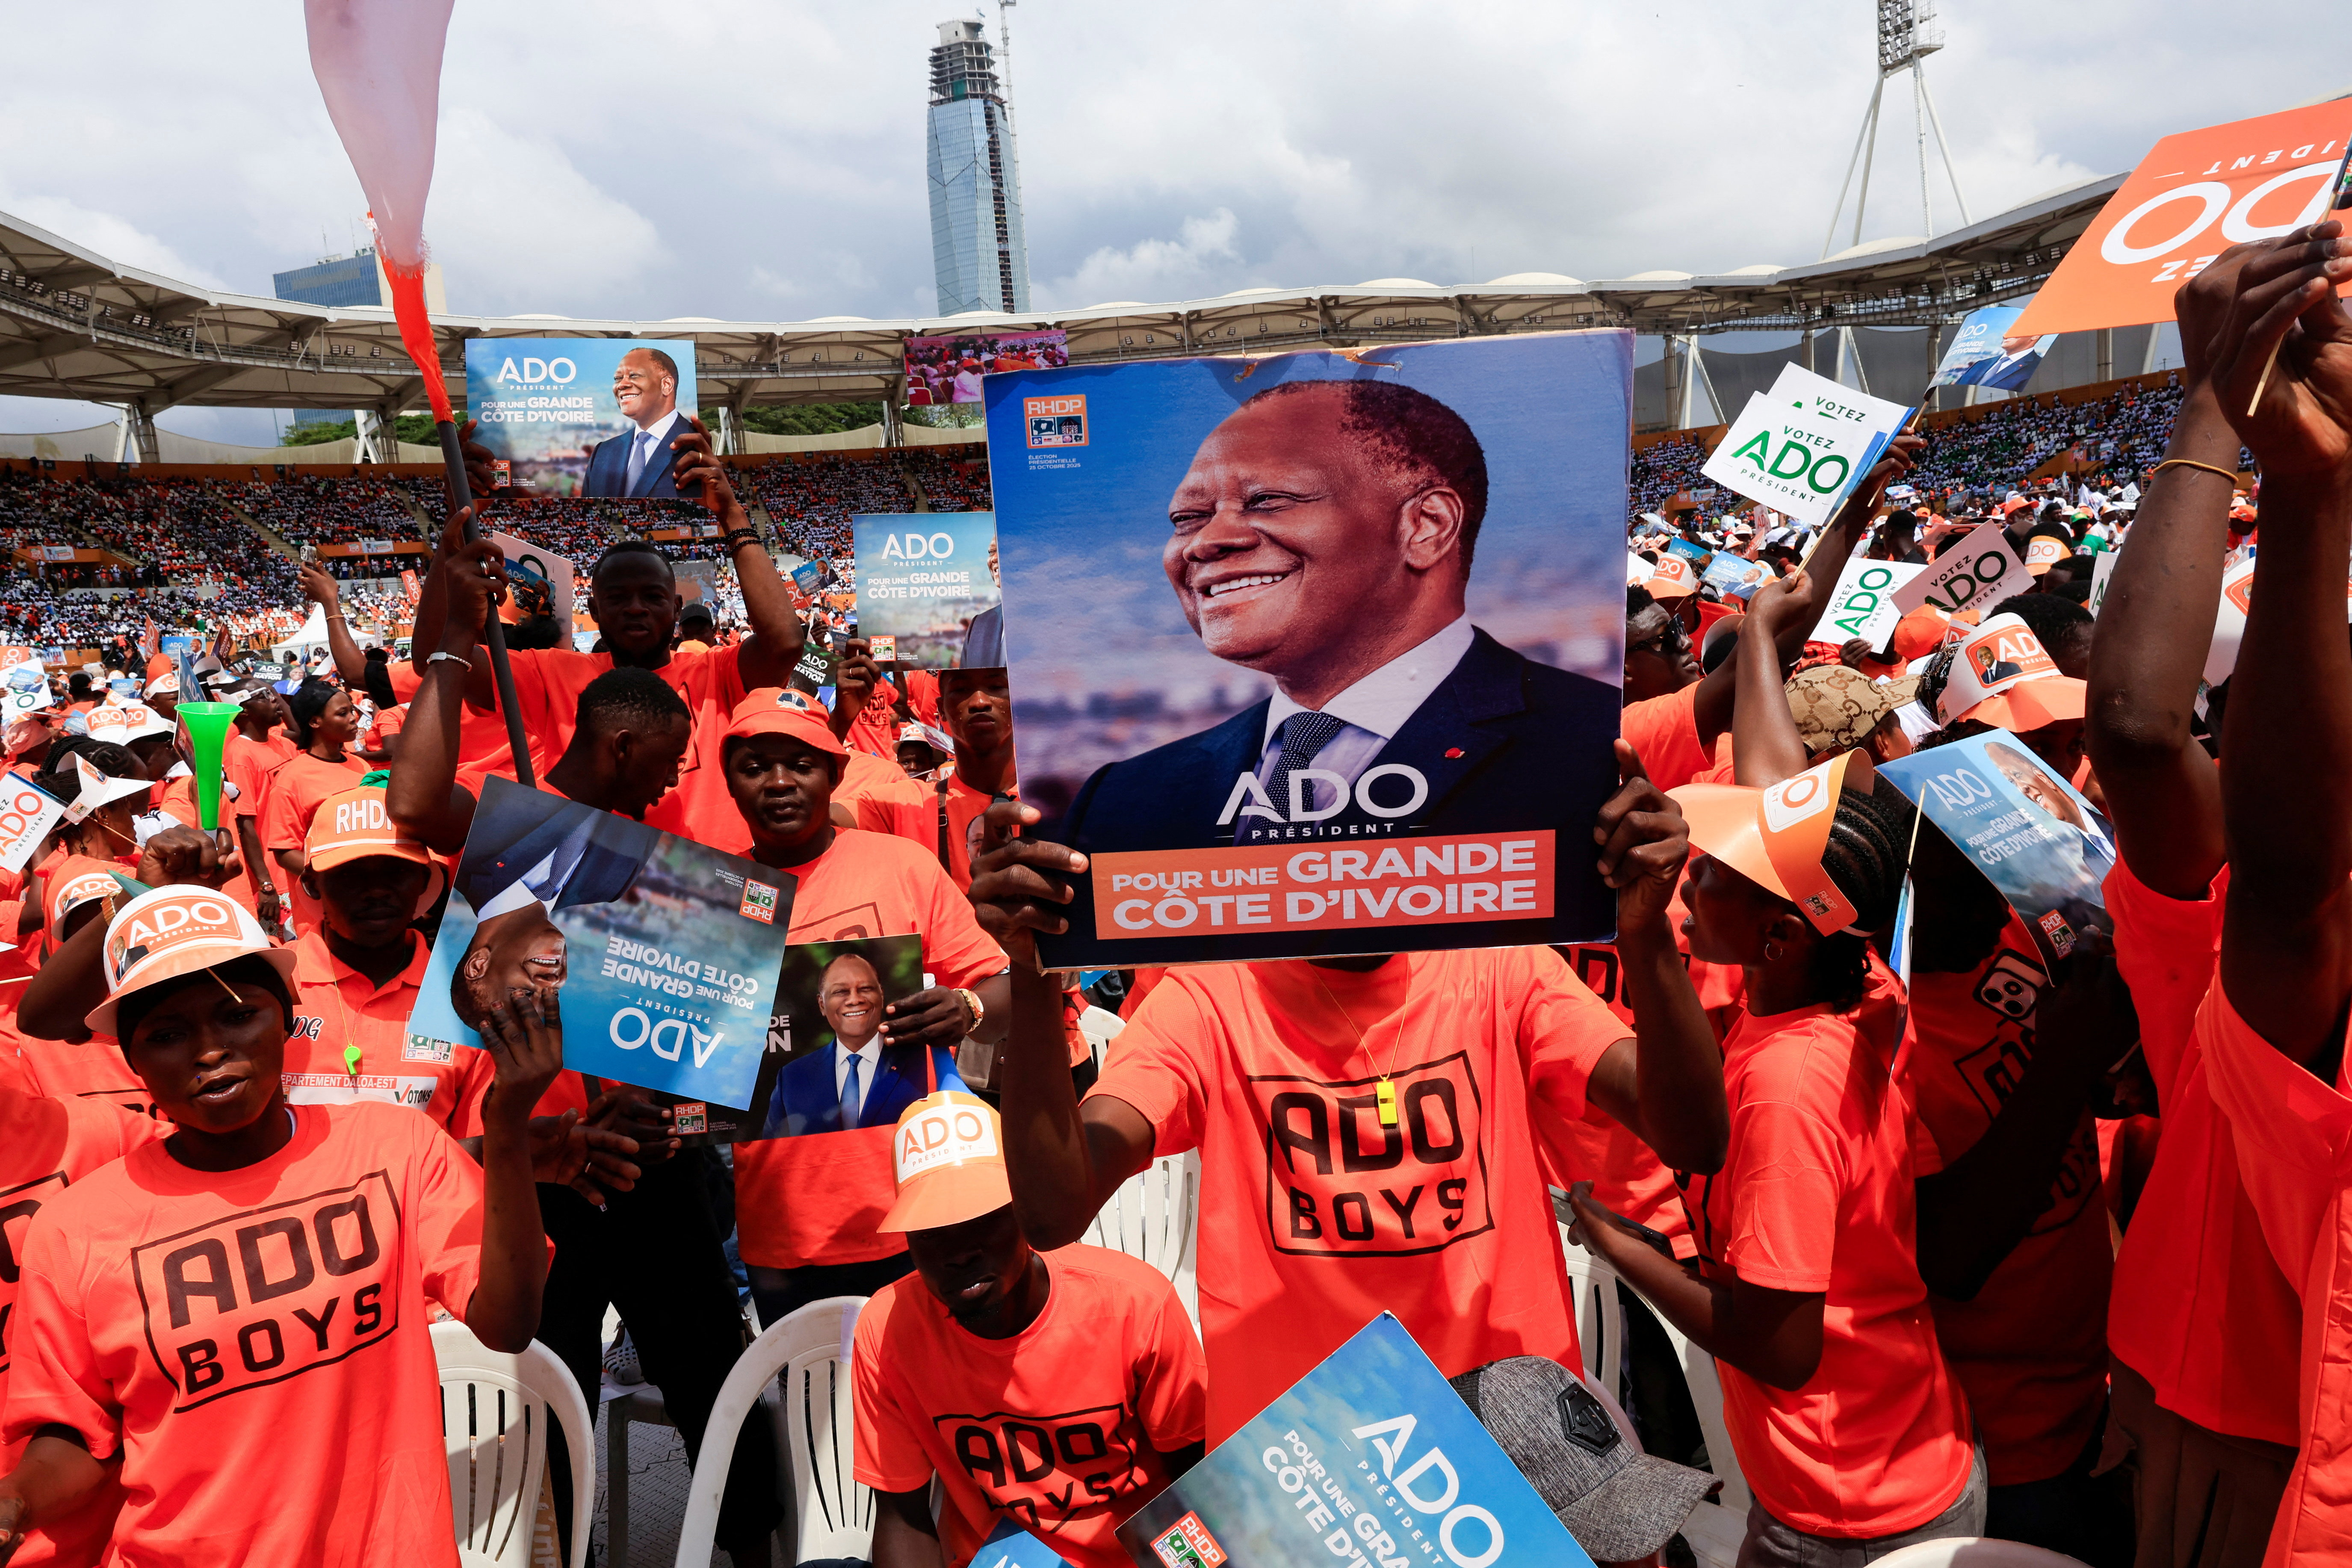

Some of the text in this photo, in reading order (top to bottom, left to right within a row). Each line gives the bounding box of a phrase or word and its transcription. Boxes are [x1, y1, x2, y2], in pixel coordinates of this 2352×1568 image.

[2101, 159, 2343, 264] DO
[1956, 324, 1988, 341] ADO
[496, 357, 576, 384] ADO
[481, 408, 594, 423] CÔTE D'IVOIRE
[528, 397, 593, 409] GRANDE
[1028, 399, 1082, 414] RHDP
[1816, 396, 1866, 422] VOTEZ
[1784, 425, 1835, 449] VOTEZ
[1730, 430, 1849, 494] ADO
[1740, 469, 1816, 502] PRÉSIDENT
[2126, 488, 2136, 501] ADO
[881, 533, 954, 559] ADO
[1677, 547, 1693, 558] ADO
[910, 572, 969, 584] GRANDE
[1720, 560, 1738, 570] ADO
[1930, 555, 1972, 587] VOTEZ
[406, 575, 419, 601] ADO
[868, 585, 970, 599] CÔTE D'IVOIRE
[1924, 551, 2007, 612] ADO
[1830, 584, 1853, 614] VOTEZ
[1834, 568, 1892, 636] ADO
[1870, 581, 1899, 627] PRÉSIDENT
[6, 648, 20, 666] DO
[802, 653, 828, 670] ADO
[793, 665, 824, 684] NATION
[808, 667, 826, 678] GRANDE
[91, 711, 122, 726] ADO
[127, 711, 144, 722] DO
[1216, 763, 1428, 825] ADO
[1926, 768, 1992, 812] ADO
[1964, 800, 1998, 818] PRÉSIDENT
[15, 812, 47, 852] PRÉSIDENT
[1252, 823, 1395, 839] PRÉSIDENT
[1965, 807, 2036, 848] POUR UNE GRANDE
[1979, 823, 2053, 865] CÔTE D'IVOIRE
[725, 871, 740, 880] OCTOBRE
[1112, 839, 1536, 892] POUR UNE GRANDE
[70, 880, 121, 899] ADO
[1818, 890, 1838, 910] RHDP
[742, 904, 773, 921] RHDP
[1113, 879, 1536, 930] CÔTE D'IVOIRE
[129, 902, 228, 949] ADO
[149, 926, 217, 945] PRÉSIDENT
[2041, 913, 2061, 932] RHDP
[606, 936, 758, 995] CÔTE D'IVOIRE
[601, 958, 755, 1010] POUR UNE GRANDE
[636, 997, 710, 1024] PRÉSIDENT
[609, 1007, 725, 1068] ADO
[281, 1075, 395, 1089] EPARTEMENT DALOA-EST
[394, 1084, 432, 1104] VOTONS
[676, 1105, 704, 1115] RHDP
[902, 1111, 983, 1165] ADO
[1271, 1078, 1464, 1175] ADO
[912, 1145, 972, 1167] PRÉSIDNT
[1289, 1177, 1467, 1241] BOYS
[163, 1194, 380, 1330] ADO
[177, 1283, 381, 1395] BOYS
[955, 1421, 1108, 1488] ADO
[1262, 1446, 1335, 1534] CÔTE
[1283, 1429, 1327, 1482] POUR
[1322, 1478, 1356, 1518] UNE
[1353, 1512, 1411, 1568] GRA
[1351, 1414, 1504, 1568] ADO
[1357, 1460, 1444, 1565] PRÉSIDENT
[1180, 1516, 1220, 1562] RHDP
